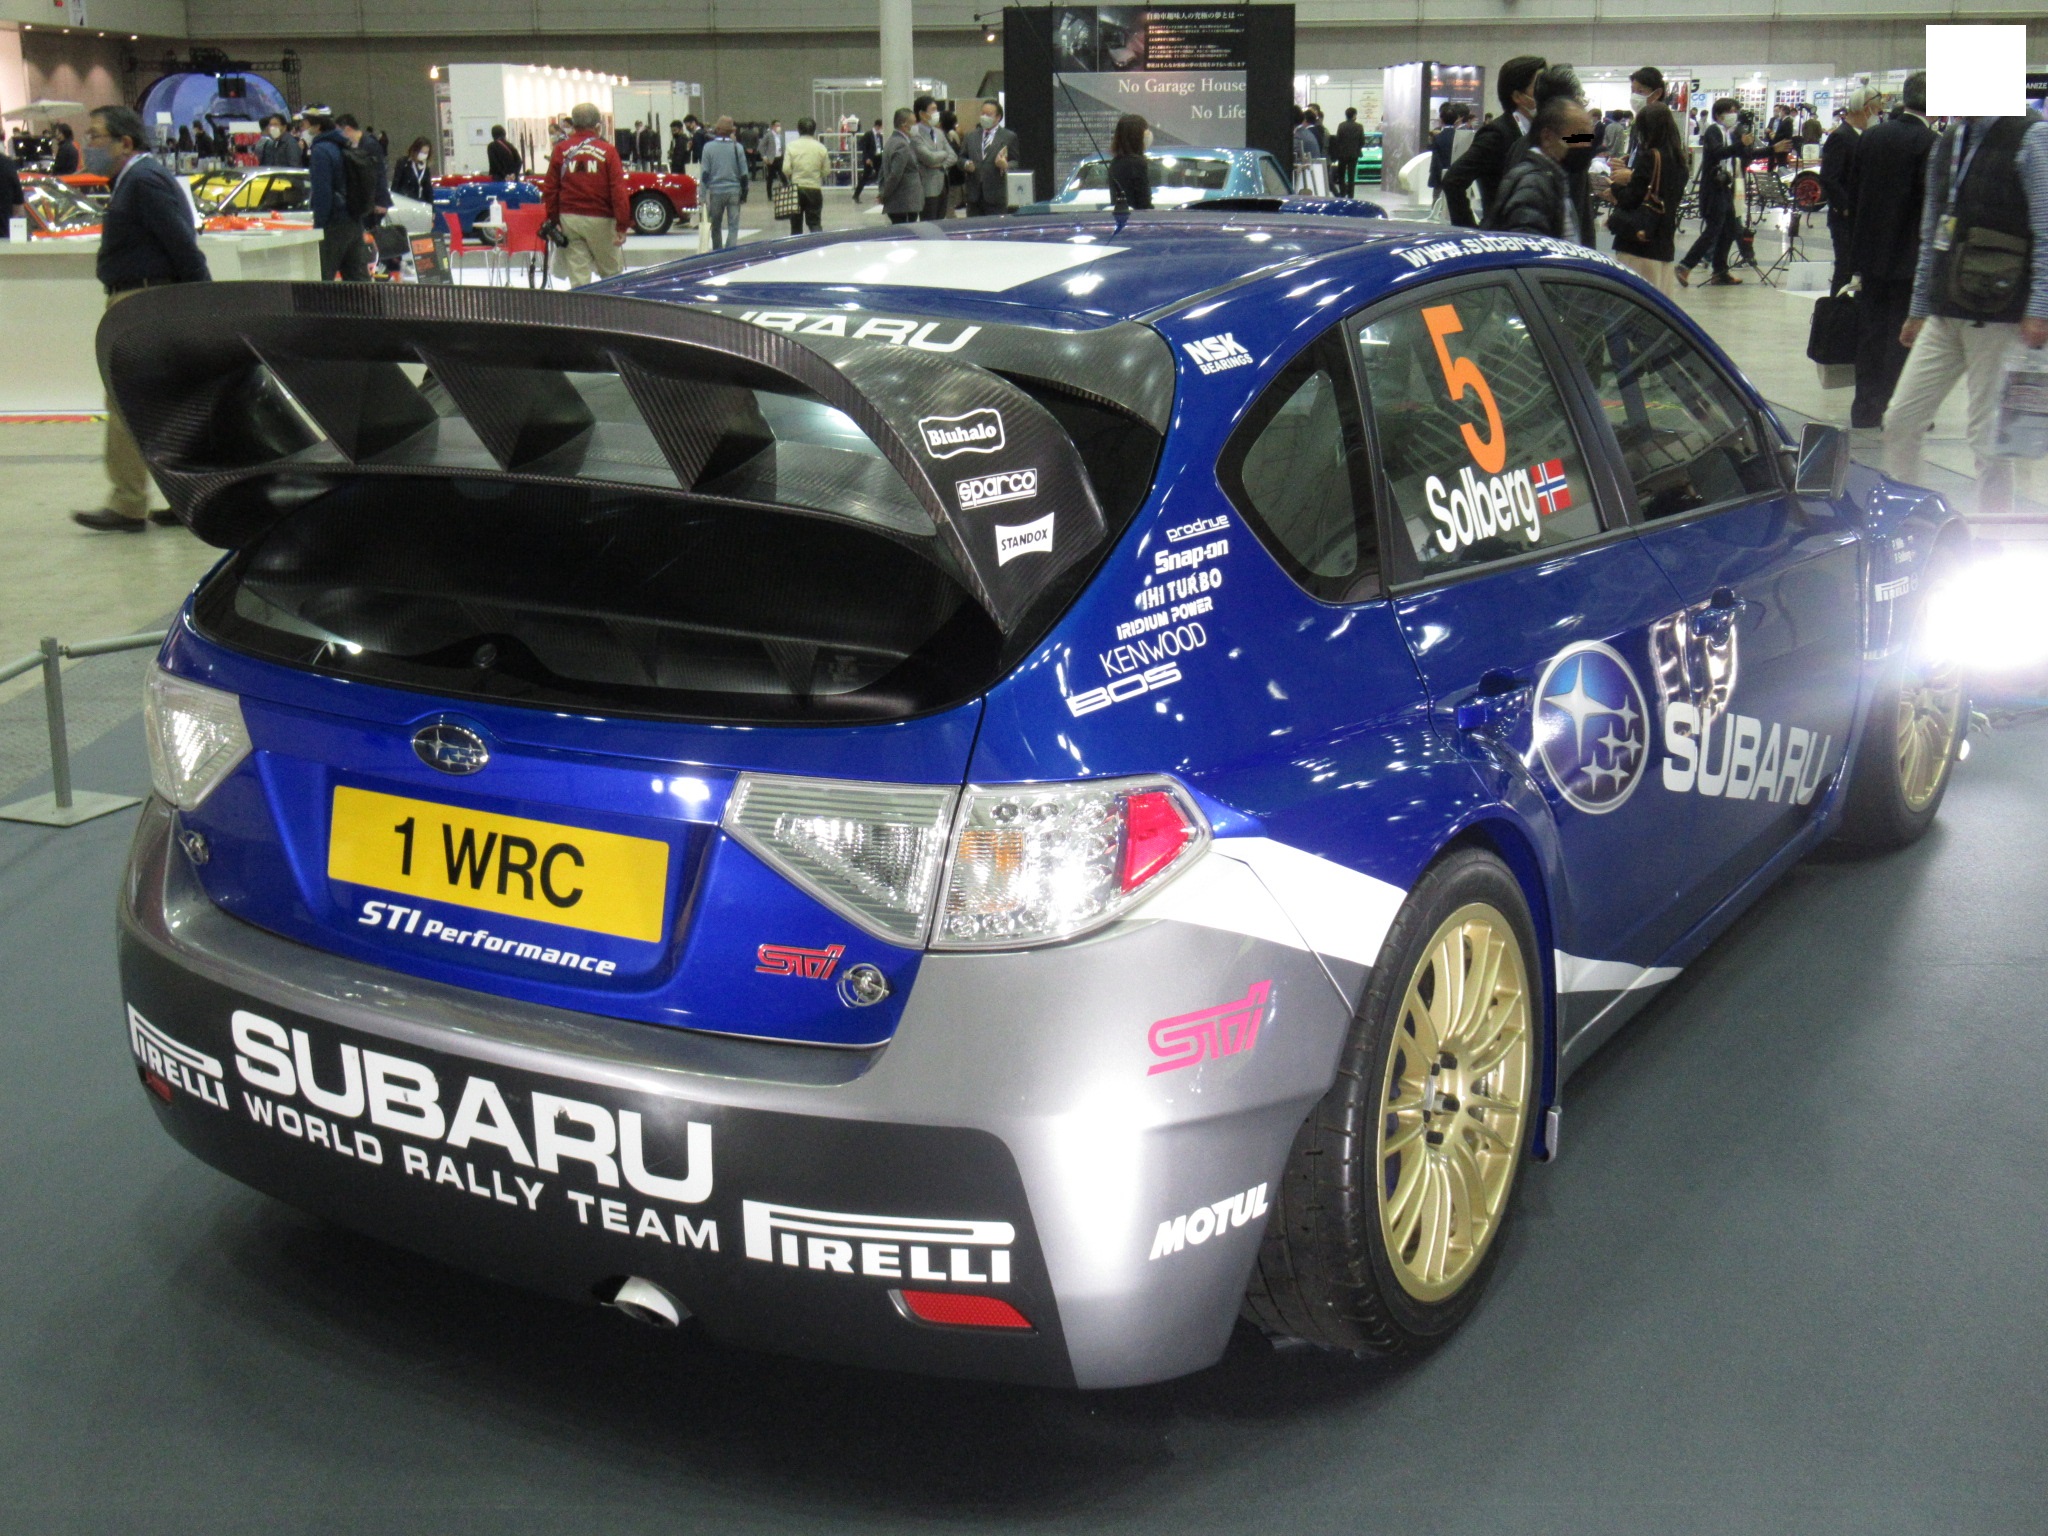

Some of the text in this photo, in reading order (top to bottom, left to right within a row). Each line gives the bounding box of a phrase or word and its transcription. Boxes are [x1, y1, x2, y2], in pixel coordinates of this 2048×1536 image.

[1119, 78, 1247, 96] No Garage House
[2026, 82, 2048, 90] ANIZE
[1191, 104, 1246, 119] No Life
[1182, 332, 1249, 365] NSK
[1198, 353, 1254, 376] BEARINGS
[1421, 303, 1506, 474] 5
[927, 423, 997, 446] Bluhalo
[958, 471, 1036, 507] sparco
[1425, 466, 1541, 553] Solberg
[1001, 528, 1048, 551] STANDOX
[1166, 514, 1230, 543] prodrive
[1155, 539, 1229, 575] Snap-on
[1141, 567, 1223, 611] IHI TURBO
[1116, 596, 1214, 641] IRIDIUM POWER
[1099, 622, 1207, 678] KENWOOD
[1065, 661, 1182, 718] BOS
[1662, 701, 1832, 806] SUBARU
[394, 816, 586, 909] 1 WRC
[358, 900, 618, 977] STI Performance
[127, 1001, 230, 1111] PIRELLI
[231, 1009, 714, 1204] SUBARU
[242, 1090, 720, 1253] WORLD RALLY TEAM
[742, 1199, 1016, 1284] PIRELLI
[1148, 1182, 1269, 1261] MOTUL
